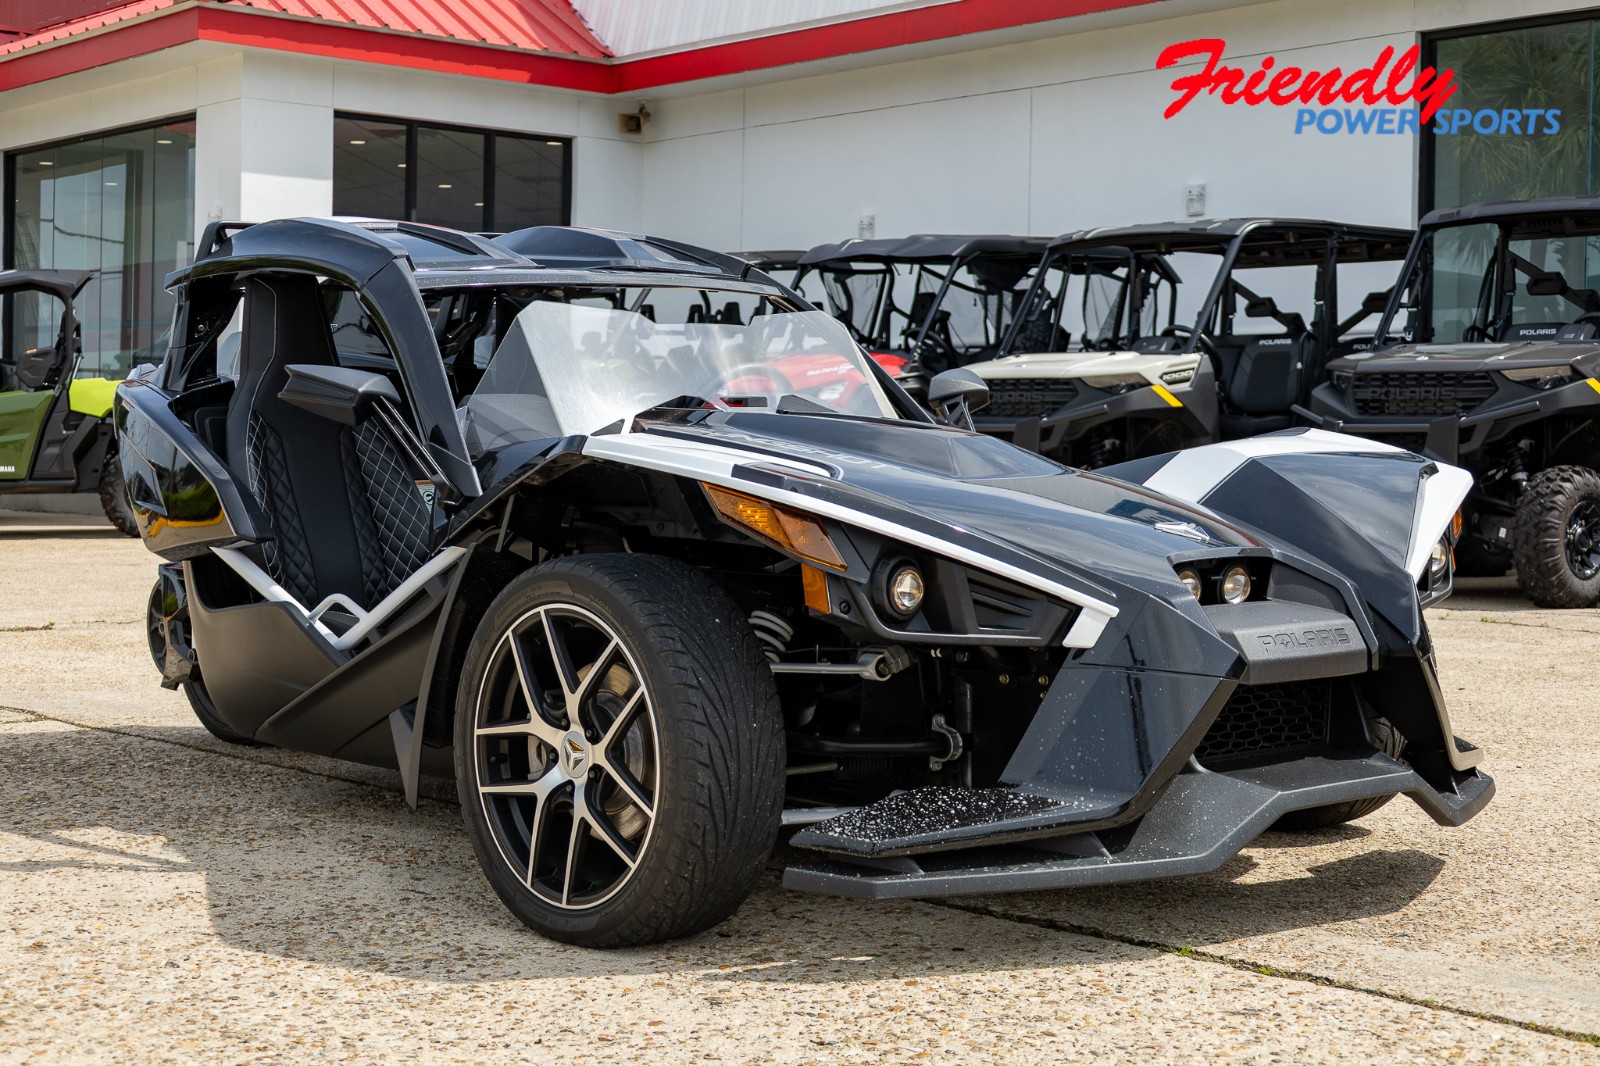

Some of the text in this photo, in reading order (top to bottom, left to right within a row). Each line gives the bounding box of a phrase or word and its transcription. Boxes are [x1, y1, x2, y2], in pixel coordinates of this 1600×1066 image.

[1520, 328, 1557, 336] POLARIS
[1258, 338, 1293, 346] POLARIS
[1162, 371, 1194, 381] 1000
[989, 391, 1043, 403] OLARIS
[1367, 387, 1457, 400] POLARIS
[1257, 628, 1351, 652] POLARIS
